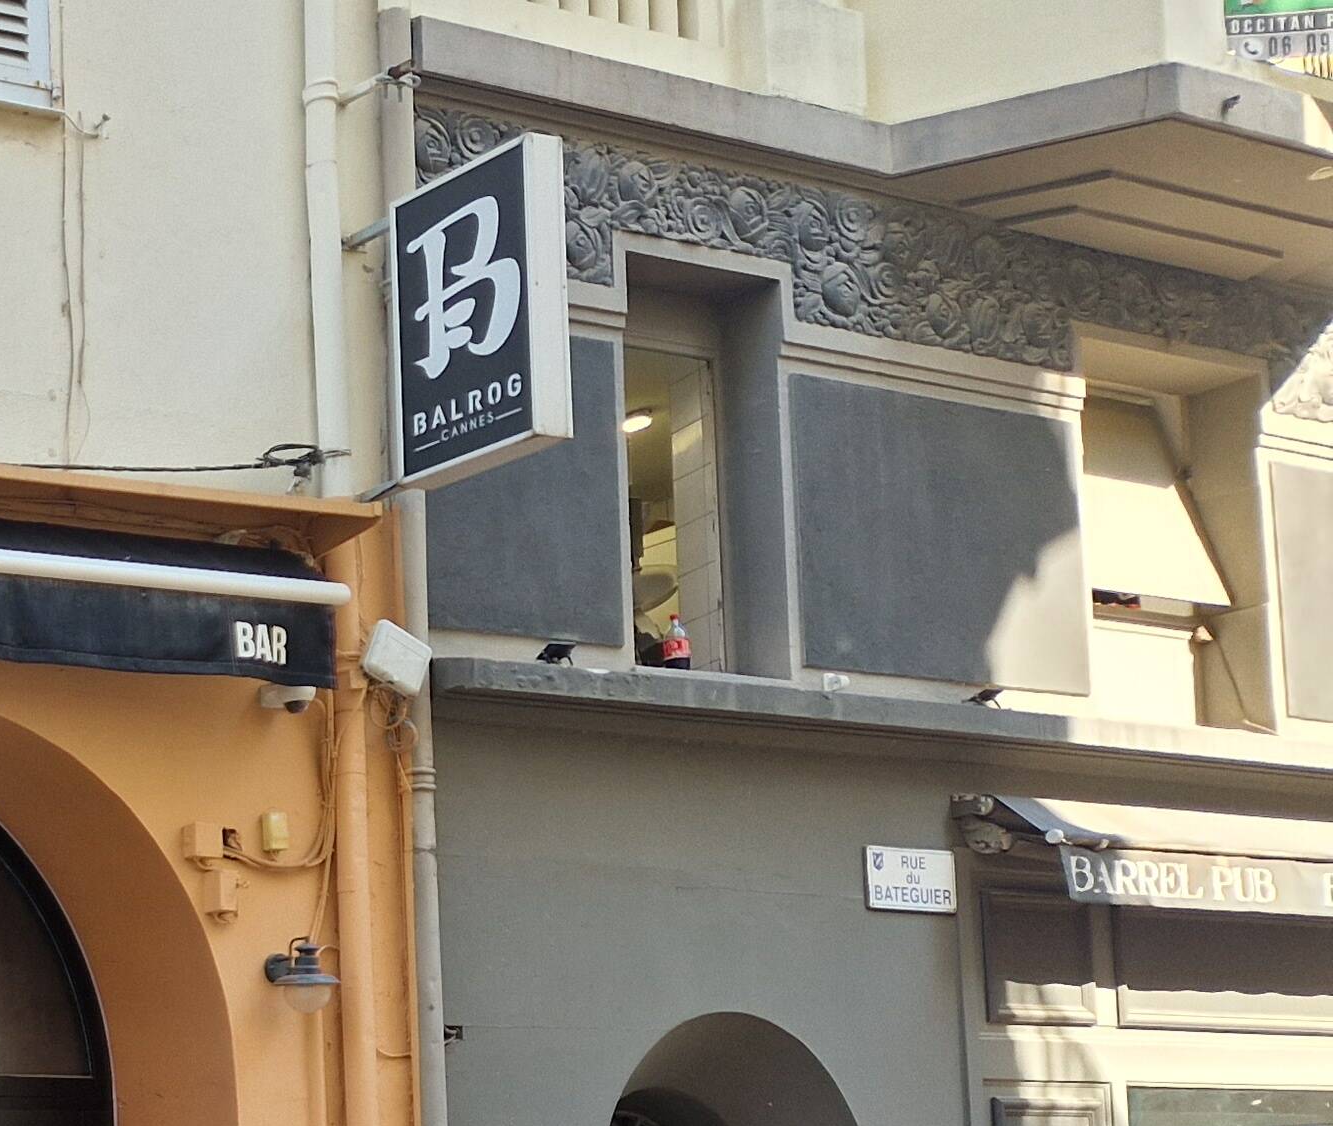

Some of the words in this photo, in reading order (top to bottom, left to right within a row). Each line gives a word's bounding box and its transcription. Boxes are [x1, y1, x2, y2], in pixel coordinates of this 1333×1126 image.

[1231, 14, 1315, 34] OCCITAN
[1268, 35, 1292, 56] 06
[1306, 32, 1330, 54] 09
[406, 195, 521, 380] B
[413, 372, 523, 437] BALROG
[440, 411, 495, 442] CANNES
[234, 620, 288, 666] BAR
[900, 855, 927, 870] RUE
[906, 872, 921, 885] du
[1069, 855, 1204, 900] BARREL
[1210, 865, 1277, 904] PUB
[874, 884, 952, 906] BATEGUIER
